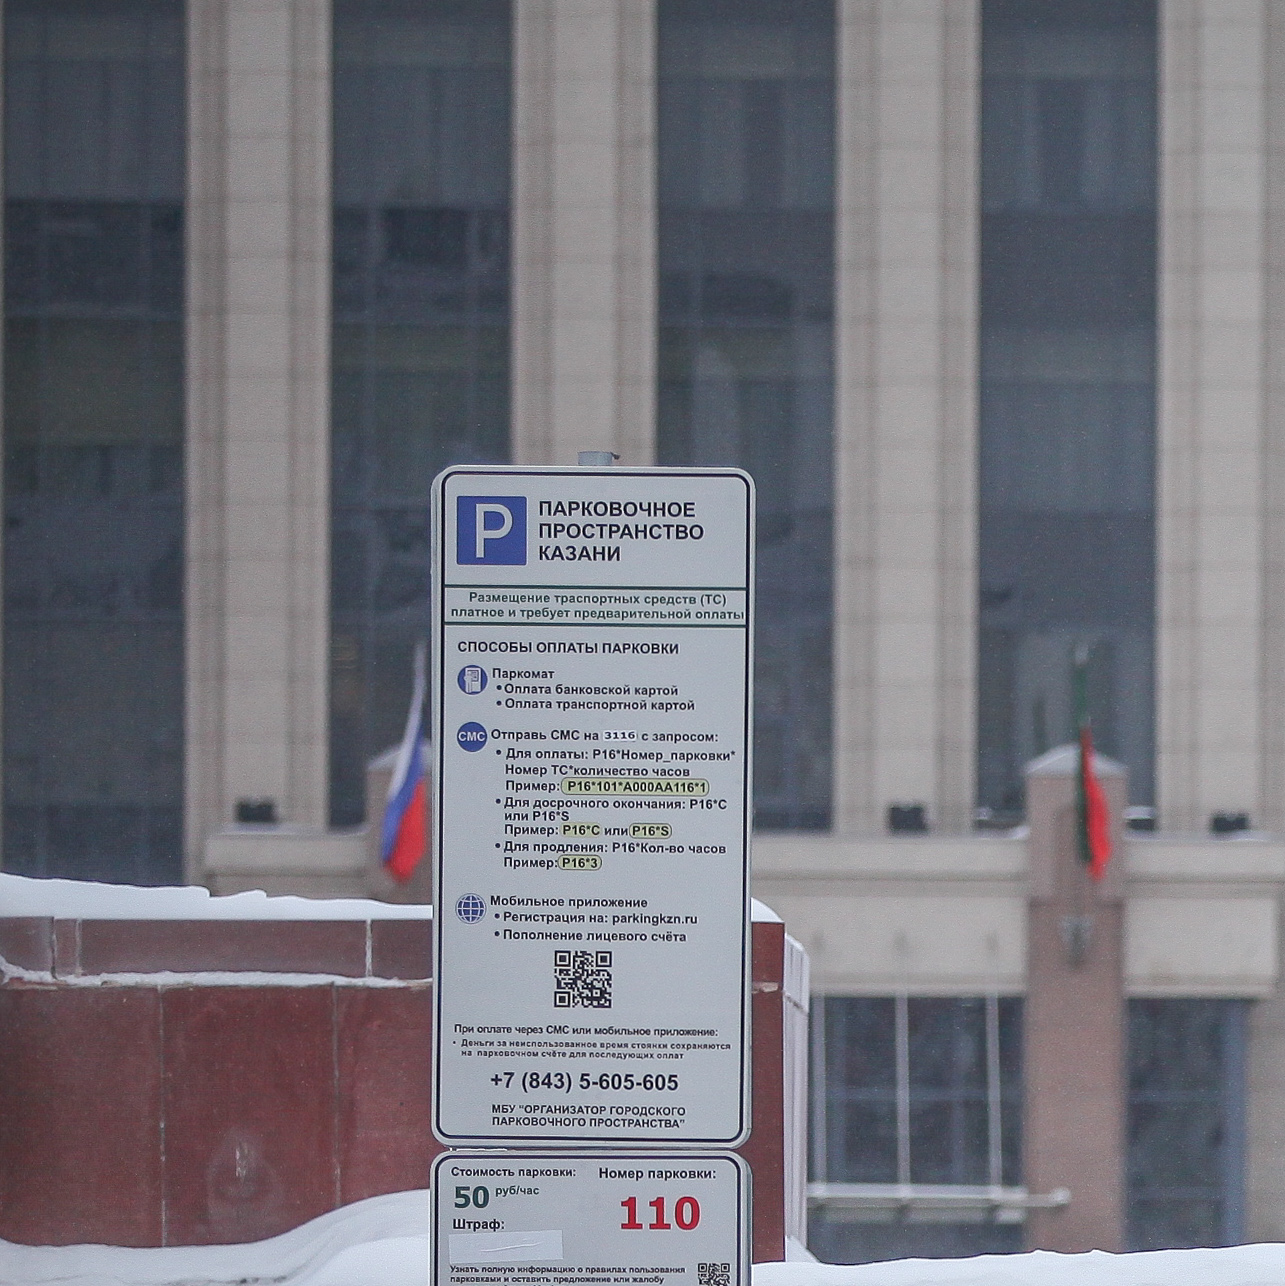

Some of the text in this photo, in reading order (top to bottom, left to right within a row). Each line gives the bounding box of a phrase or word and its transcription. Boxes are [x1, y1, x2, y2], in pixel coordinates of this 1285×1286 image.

[539, 501, 695, 518] ПАРКОВОЧНОЕ
[475, 503, 514, 558] P
[539, 523, 704, 540] ПРОСТРАНСТВО
[539, 545, 621, 562] КАЗАНИ
[469, 591, 727, 607] Размещение траспортных средств (ТС)
[451, 607, 744, 622] платное и требует предварительной оплаты
[458, 641, 680, 655] СПОСОБЫ ОПЛАТЫ ПАРКОВКИ
[492, 668, 555, 681] Паркомат
[504, 683, 679, 697] Оплата банковской картой
[505, 698, 695, 713] Оплата транспортной картой
[458, 731, 486, 742] СМС
[491, 729, 718, 743] Отправь СМС на 3116 с запросом:
[506, 748, 532, 760] Для
[535, 750, 588, 760] оплаты:
[505, 764, 547, 777] Номер
[652, 768, 690, 777] часов
[505, 780, 560, 793] Пример:
[504, 797, 530, 809] Для
[533, 799, 609, 810] досрочного
[613, 800, 686, 809] окончания:
[504, 813, 529, 821] или
[504, 824, 559, 837] Пример:
[604, 828, 628, 836] или
[503, 841, 529, 853] Для
[533, 843, 608, 854] продления:
[688, 845, 726, 854] часов
[504, 857, 558, 870] Пример:
[490, 895, 648, 909] Мобильное приложение
[503, 911, 698, 926] Регистрация на: parkingkzn.ru
[503, 929, 687, 943] Пополнение лицевого счёта
[454, 1024, 718, 1038] При оплате через СМС или мобильное приложение:
[461, 1039, 495, 1048] Деньги
[509, 1040, 597, 1049] неиспользованное
[670, 1043, 731, 1051] сохраняются
[477, 1051, 539, 1059] парковочном
[541, 1050, 567, 1058] счёте
[589, 1052, 654, 1060] последующих
[490, 1071, 679, 1093] +7 (843) 5-605-605
[492, 1104, 516, 1114] МБУ
[609, 1106, 686, 1117] ГОРОДСКОГО
[492, 1116, 586, 1127] ПАРКОВОЧНОГО
[451, 1166, 576, 1178] Стоимость парковки:
[599, 1167, 716, 1181] Номер парковки:
[454, 1185, 540, 1209] 50 руб/час
[620, 1196, 700, 1230] 110
[453, 1218, 505, 1232] Штраф:
[450, 1266, 479, 1274] Узнать
[481, 1266, 515, 1275] полную
[517, 1266, 575, 1275] информацию
[585, 1266, 626, 1275] правилах
[629, 1267, 686, 1275] пользования
[450, 1276, 501, 1284] парковками
[553, 1276, 611, 1284] предложение
[631, 1276, 665, 1285] жалобу
